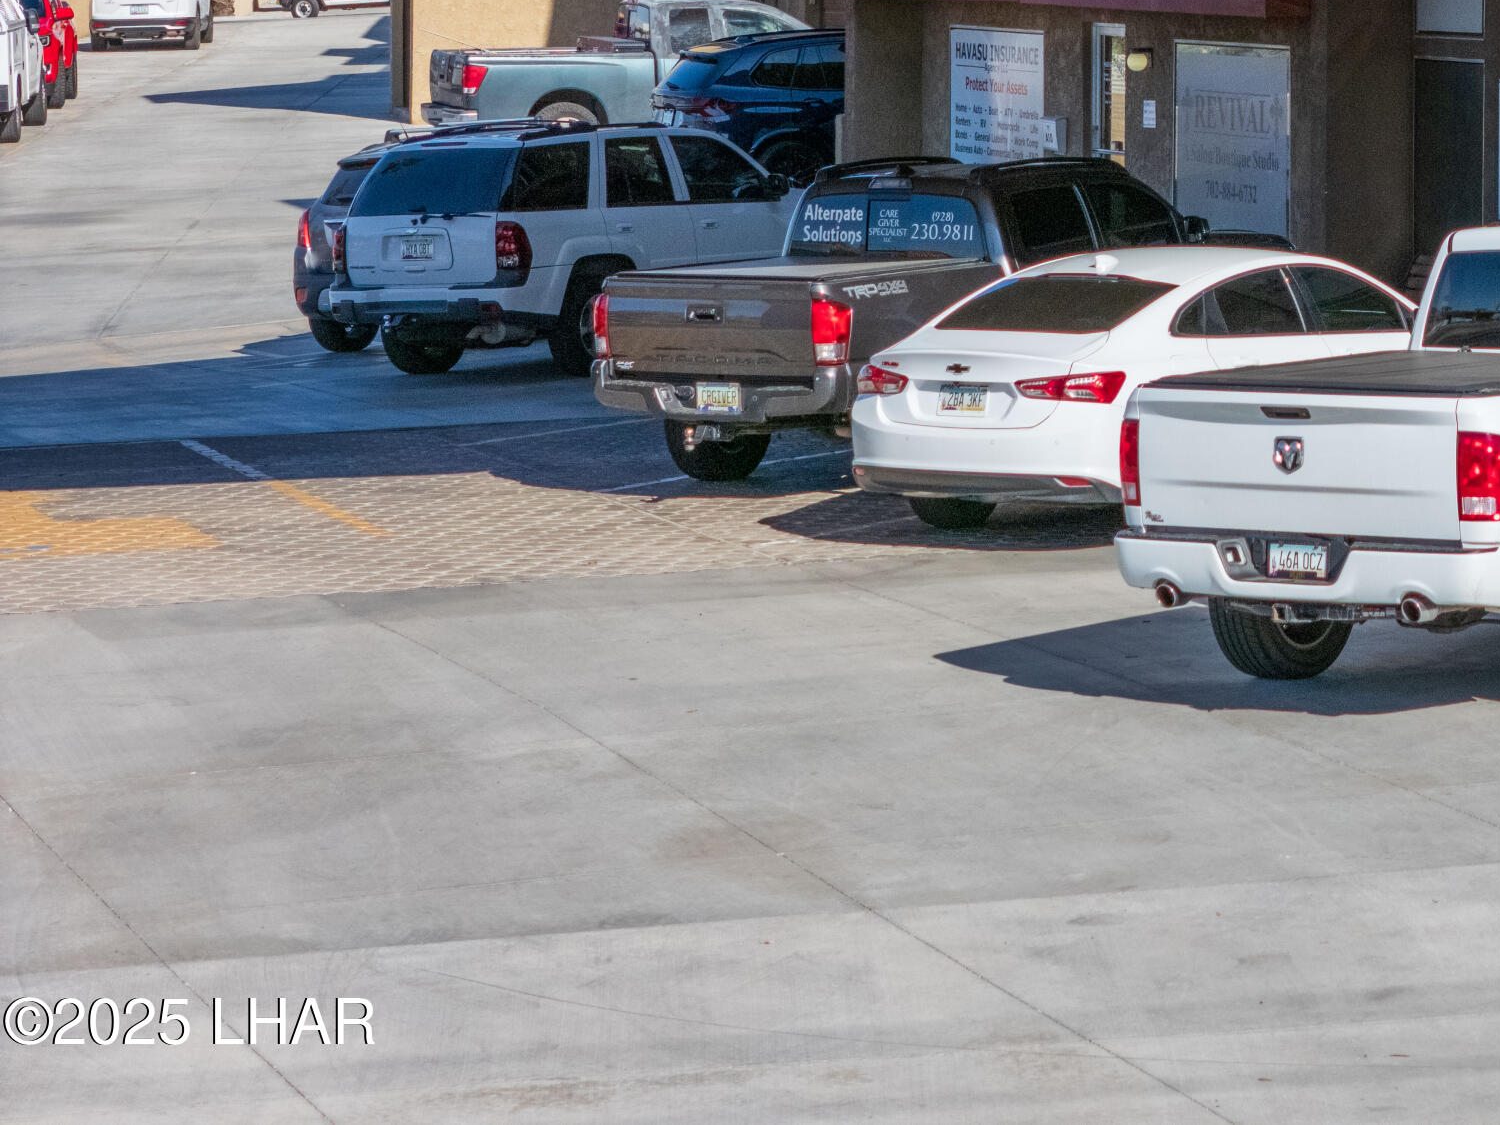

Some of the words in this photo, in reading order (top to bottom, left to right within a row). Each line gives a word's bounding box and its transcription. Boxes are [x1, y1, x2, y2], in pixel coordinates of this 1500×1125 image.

[955, 42, 988, 61] HAVASU
[990, 44, 1039, 65] INSURANCE
[965, 76, 989, 92] Protect
[989, 79, 1004, 93] Your
[1006, 80, 1028, 96] Assets
[1194, 96, 1271, 134] REVIVAL
[974, 131, 990, 142] General
[973, 144, 983, 155] Auto
[1191, 144, 1213, 164] Salon
[1215, 146, 1251, 172] Boutique
[1252, 150, 1279, 172] Studio
[1205, 179, 1257, 204] 702-884-6732
[804, 203, 863, 224] Alternate
[879, 209, 899, 218] CARE
[931, 211, 954, 223] (928)
[877, 218, 900, 227] GIVER
[802, 225, 862, 245] Solutions
[868, 227, 907, 236] SPECIALIST
[910, 223, 974, 241] 230.9811
[842, 283, 878, 300] TRD
[701, 390, 737, 404] CRGIVER
